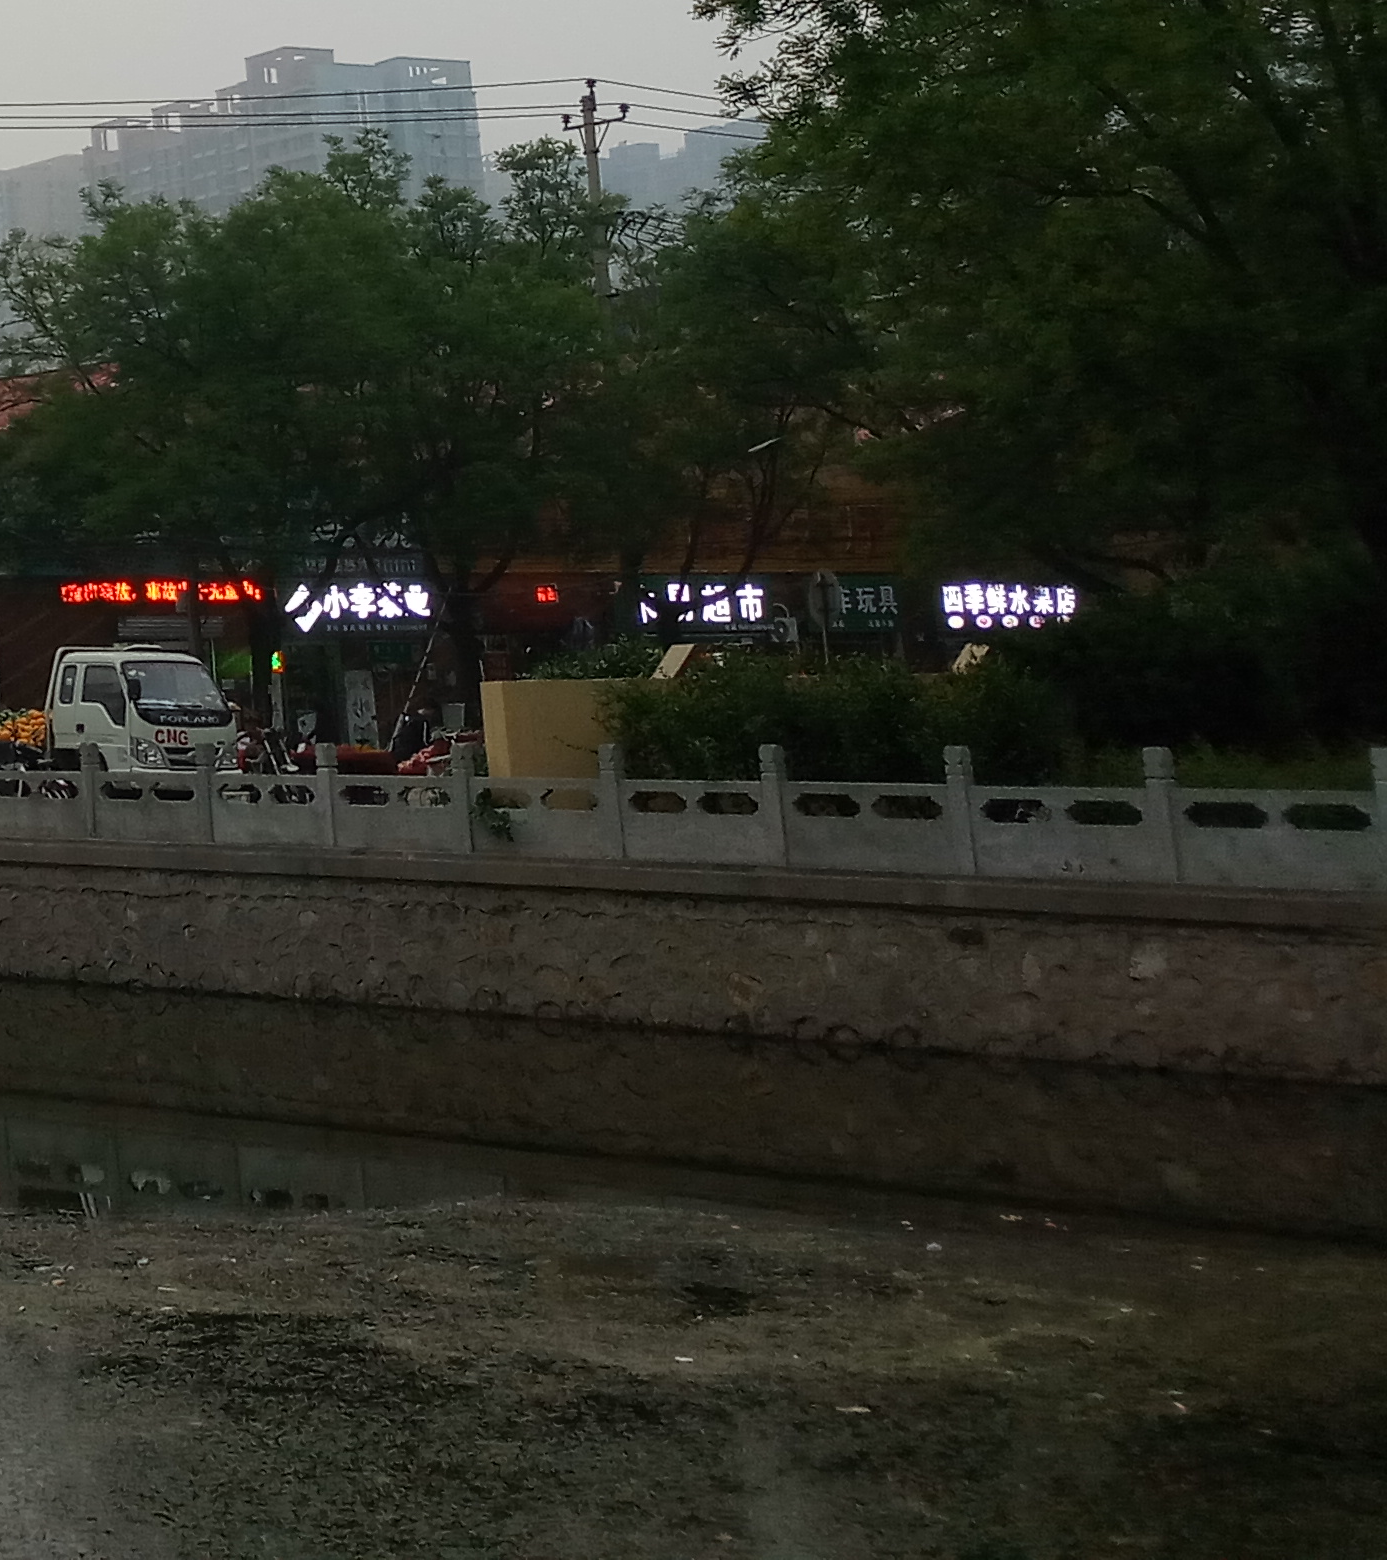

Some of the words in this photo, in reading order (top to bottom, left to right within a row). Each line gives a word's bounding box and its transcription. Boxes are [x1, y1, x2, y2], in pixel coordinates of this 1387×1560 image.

[941, 583, 1076, 615] 四季鲜水果店
[154, 729, 189, 746] CNG
